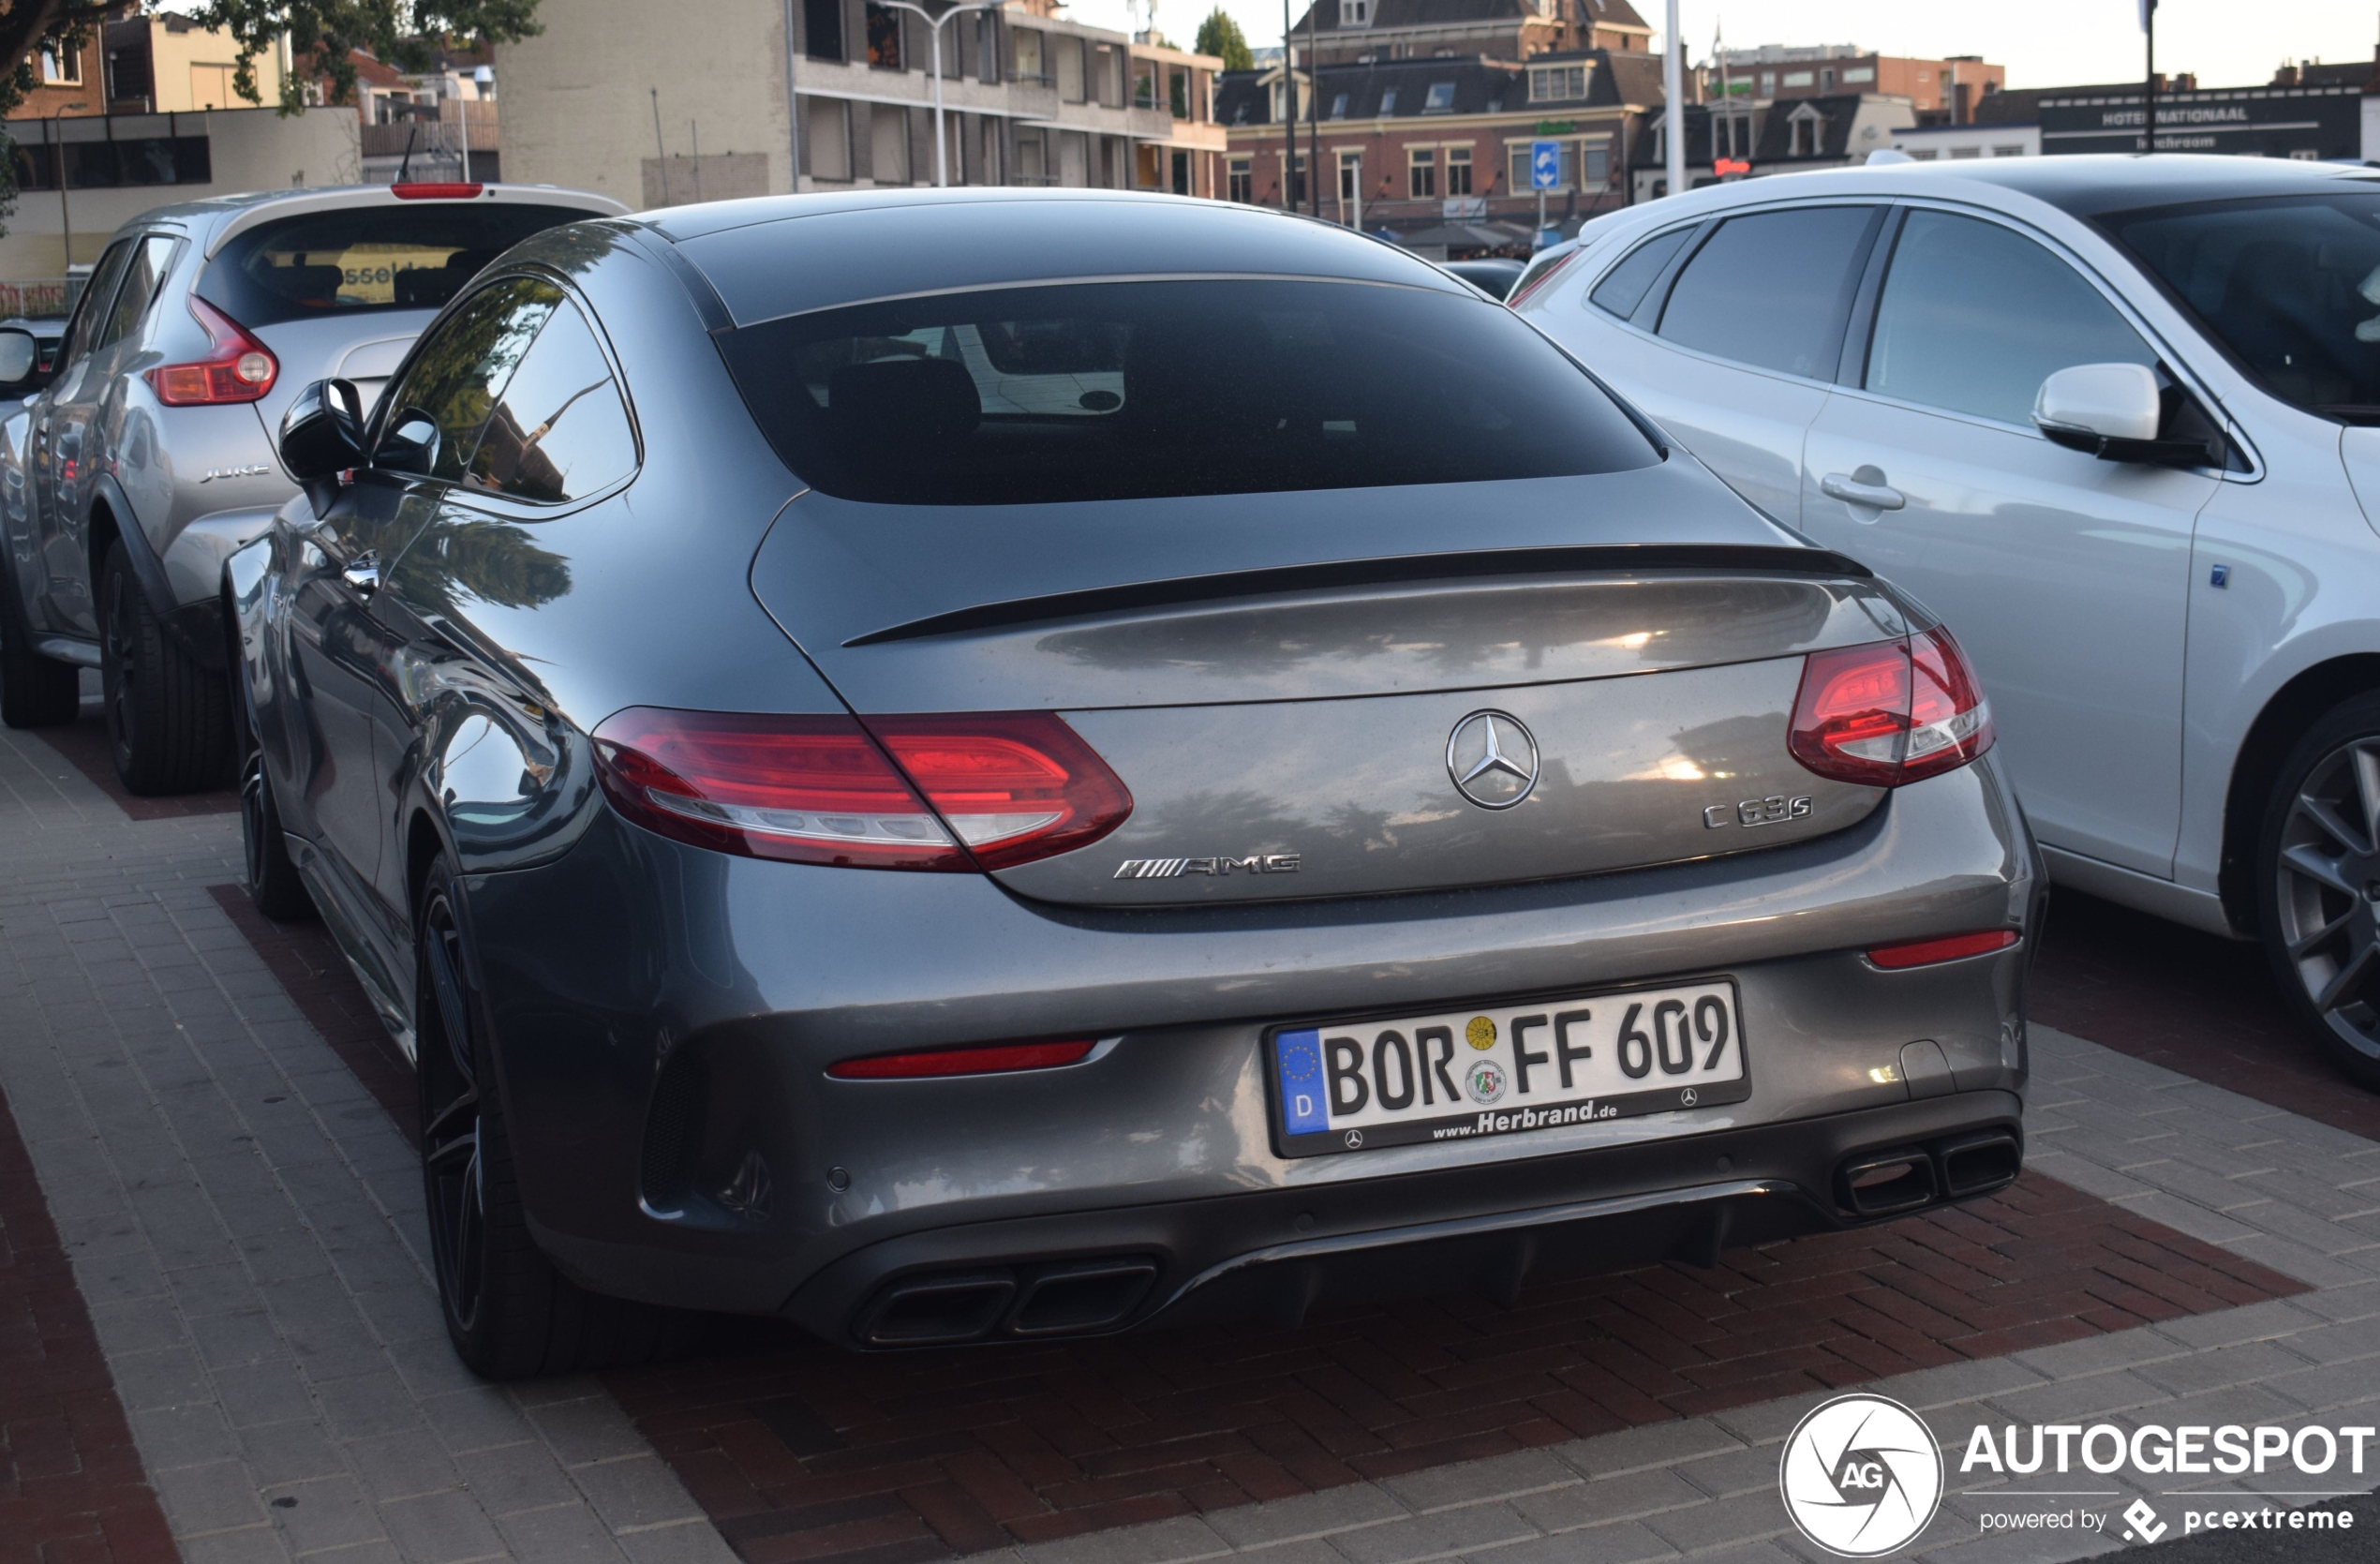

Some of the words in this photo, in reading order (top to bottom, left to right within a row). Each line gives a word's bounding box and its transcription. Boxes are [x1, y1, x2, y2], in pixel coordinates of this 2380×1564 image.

[2154, 107, 2249, 125] NATIONAAL
[200, 463, 271, 484] JUKE
[1703, 804, 1729, 829] C
[1296, 1095, 1312, 1116] D
[1324, 1025, 1461, 1116] BOR
[1510, 1008, 1592, 1094] FF
[1616, 994, 1729, 1079] 609
[1433, 1100, 1617, 1139] www.Herbrand.de
